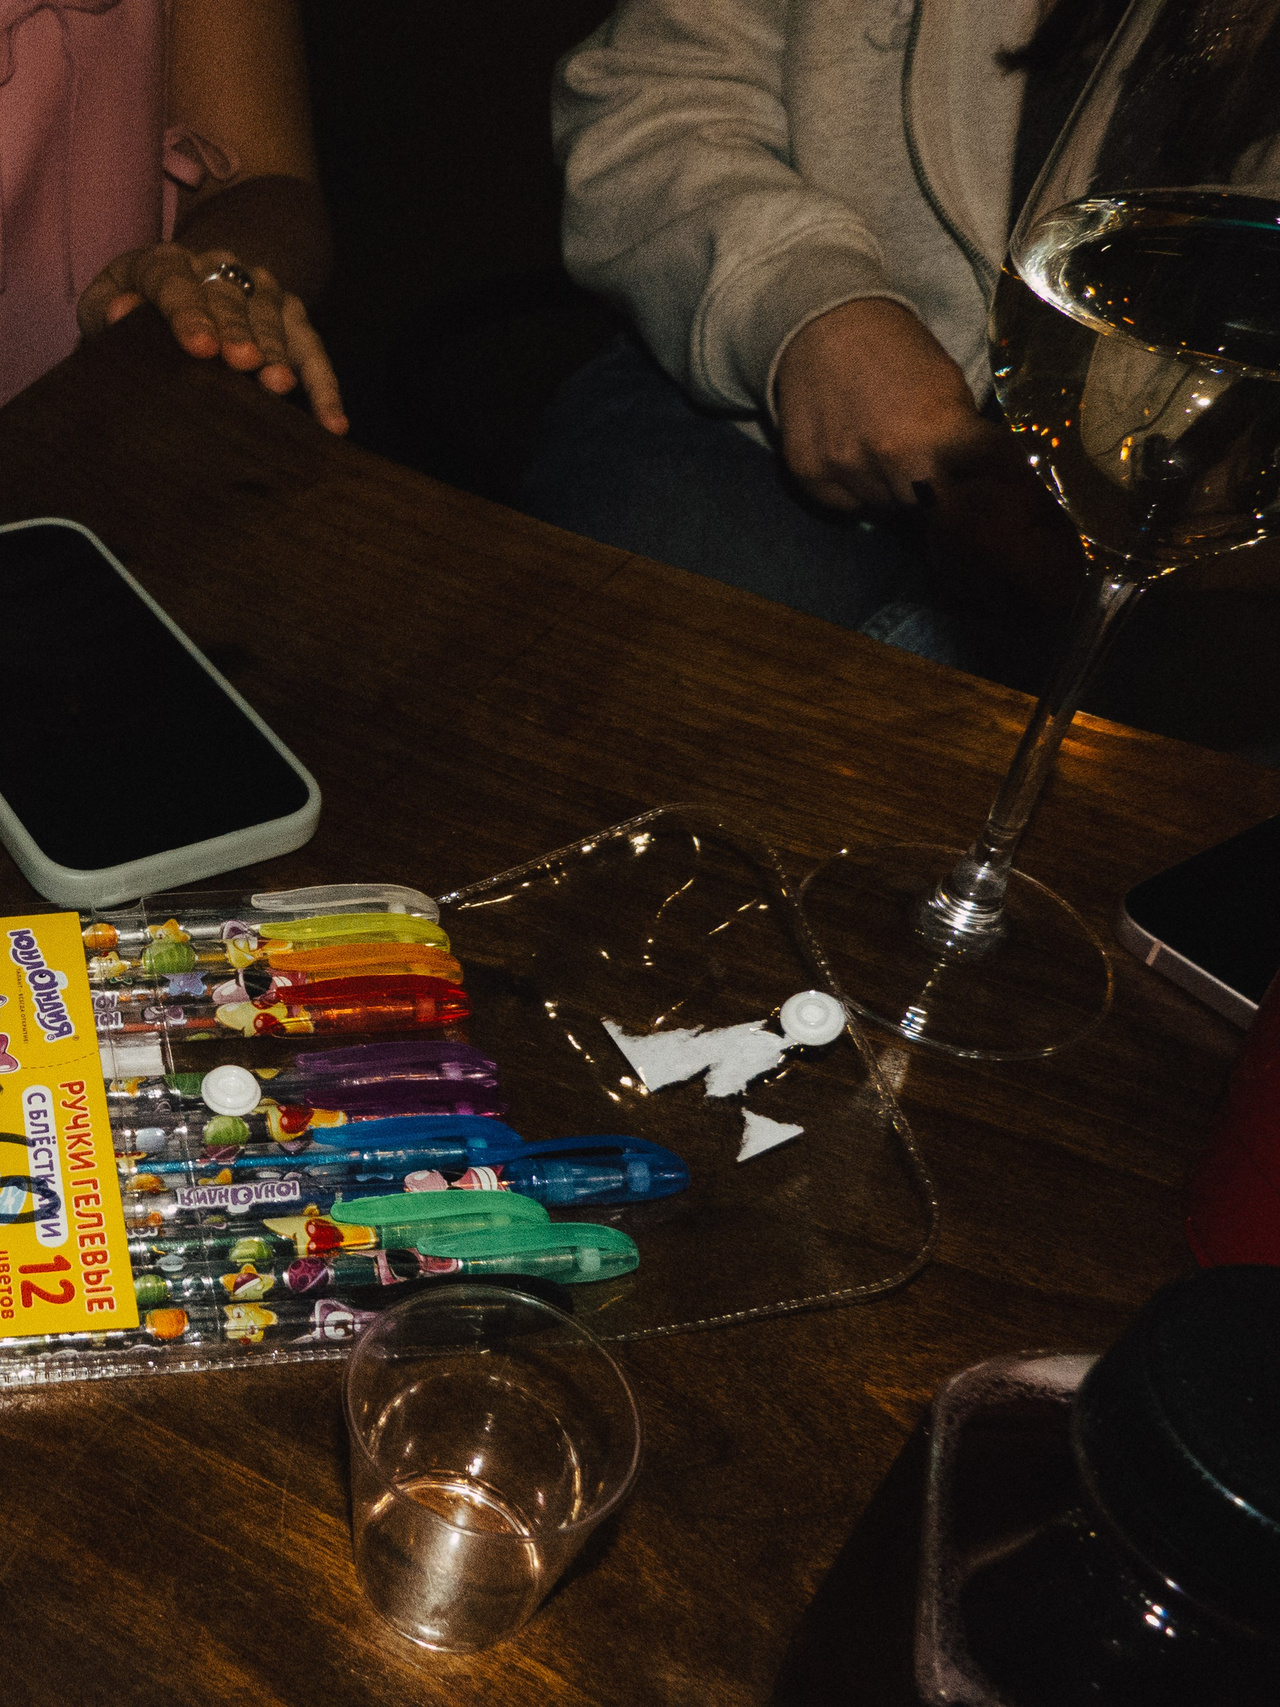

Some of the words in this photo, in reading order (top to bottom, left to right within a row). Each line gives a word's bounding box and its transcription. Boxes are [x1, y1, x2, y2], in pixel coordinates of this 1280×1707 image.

[26, 1092, 46, 1105] С
[59, 1080, 96, 1170] РУЧКИ
[28, 1109, 62, 1239] БЛЁСТКАМИ
[17, 1254, 76, 1309] 12
[69, 1178, 117, 1313] ГЕЛЕВЫЕ
